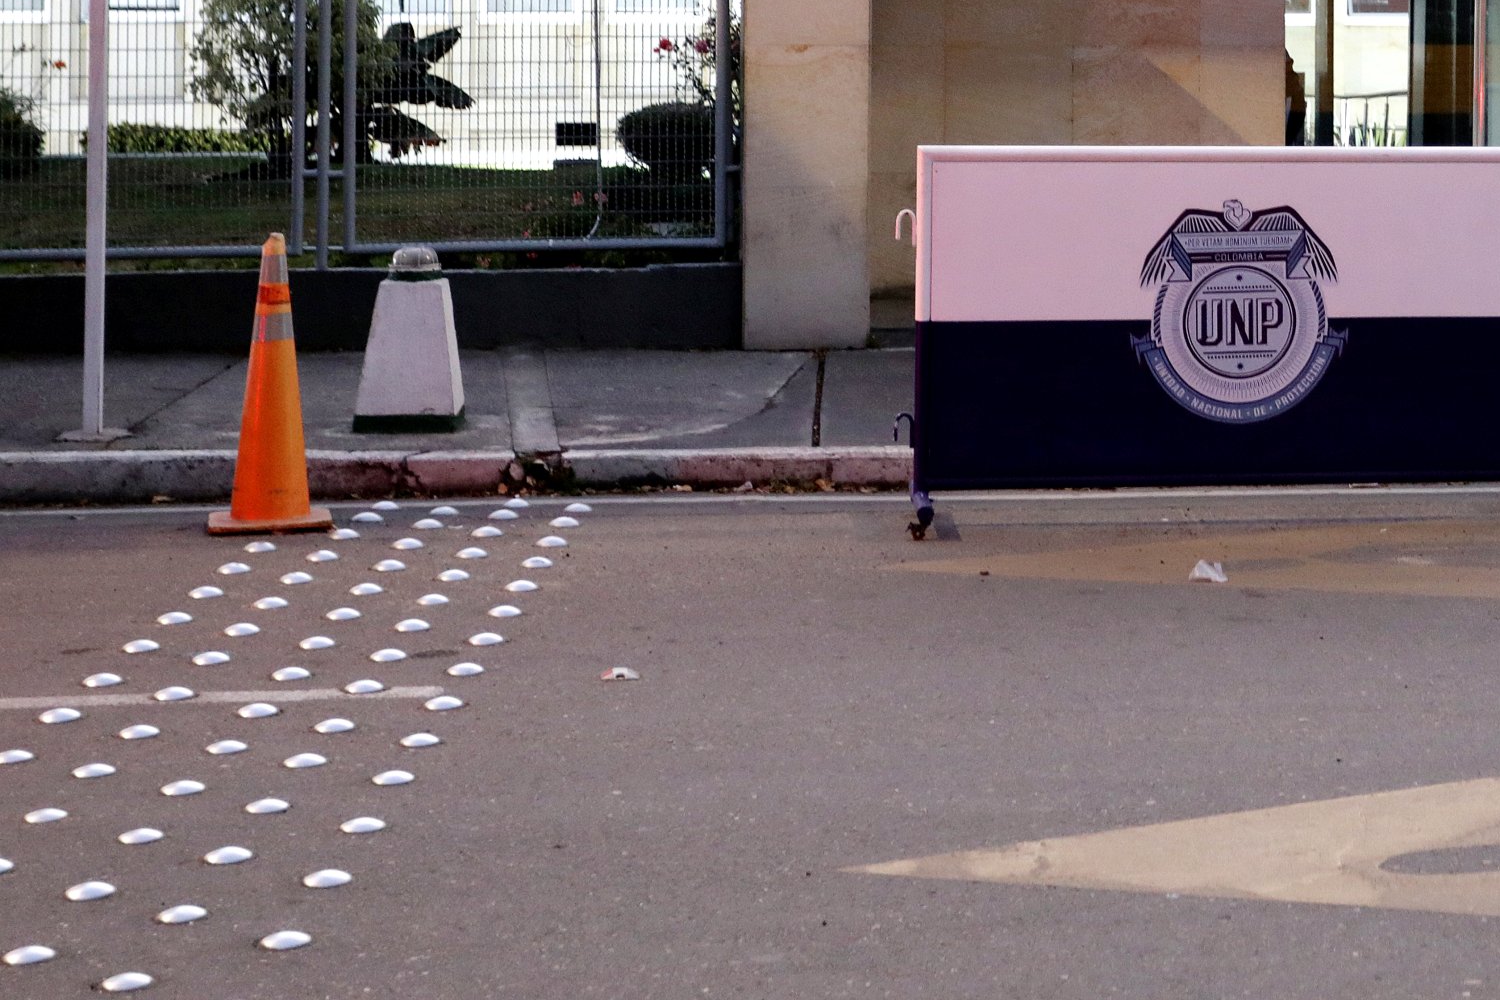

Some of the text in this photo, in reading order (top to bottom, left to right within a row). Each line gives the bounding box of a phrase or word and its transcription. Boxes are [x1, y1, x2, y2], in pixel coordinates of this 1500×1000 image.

[1214, 253, 1264, 262] COLOMBIA
[1195, 298, 1284, 346] UNP
[1154, 362, 1186, 398] UNIDAD
[1190, 397, 1243, 419] NACIONAL
[1253, 404, 1267, 417] DE
